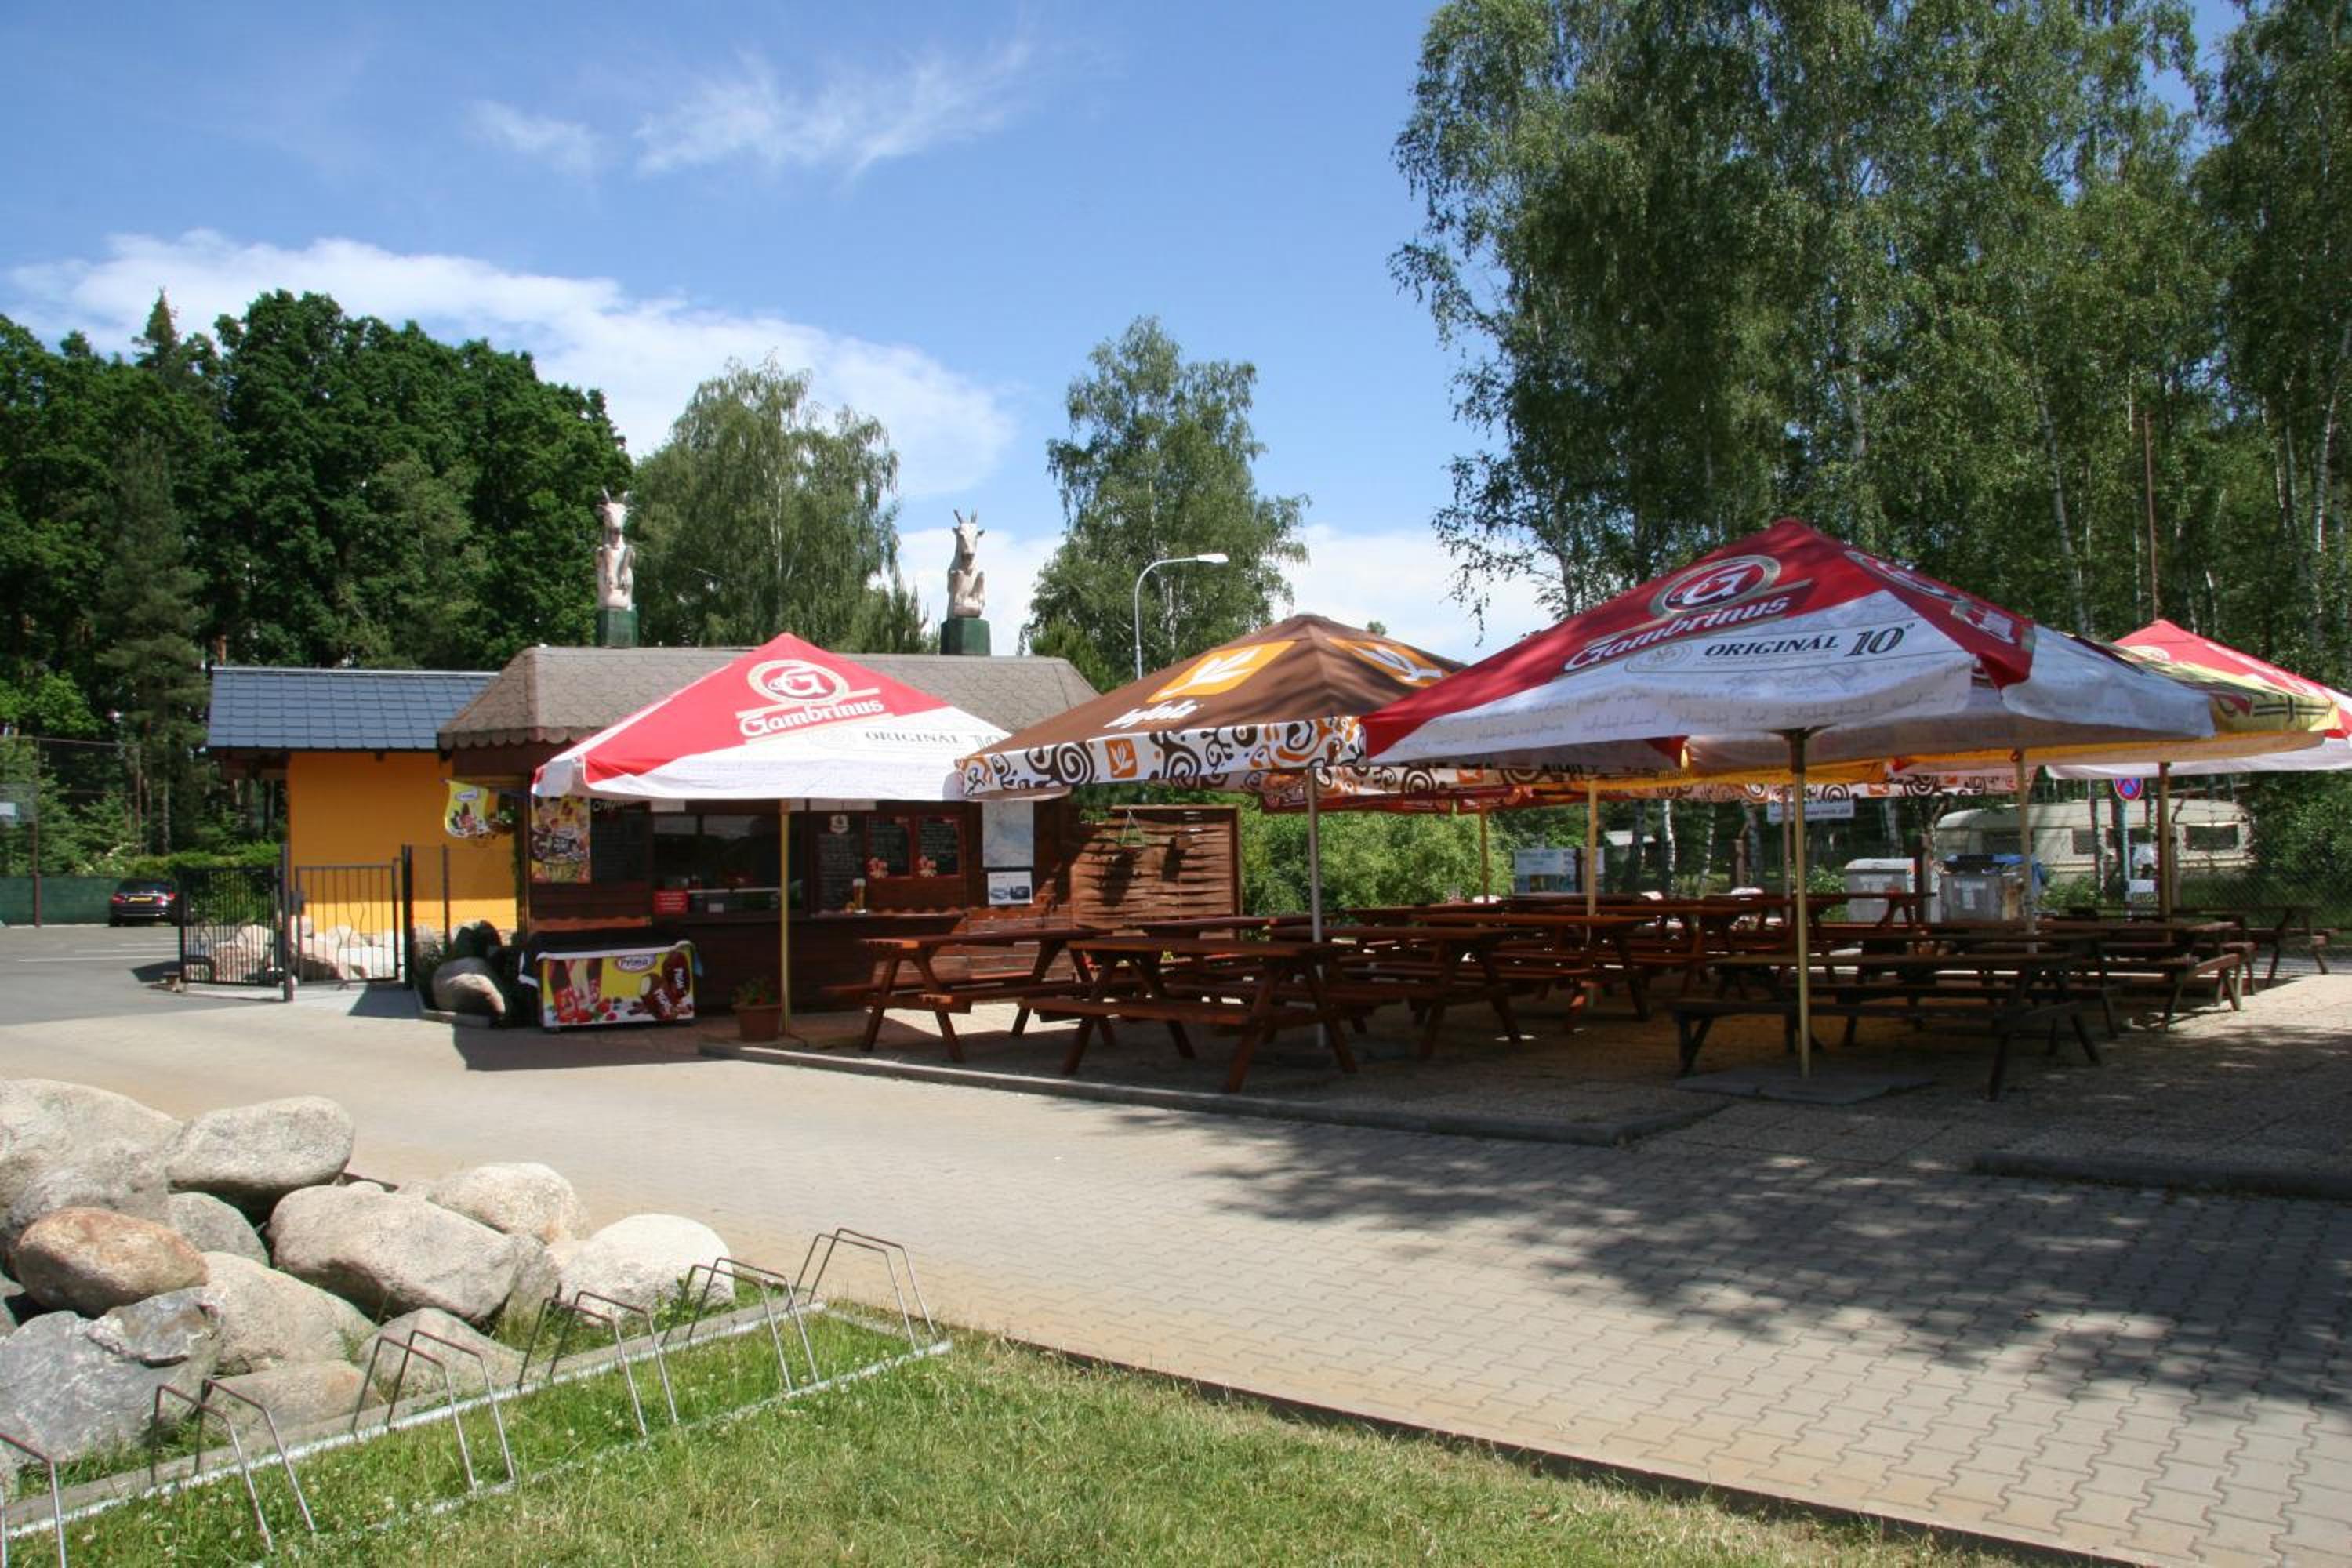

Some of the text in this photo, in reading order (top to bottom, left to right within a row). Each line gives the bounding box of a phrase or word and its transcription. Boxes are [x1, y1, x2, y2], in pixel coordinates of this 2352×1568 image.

[1564, 597, 1791, 670] Gambrinus
[1704, 635, 1838, 657] ORIGINÁL
[739, 699, 885, 737] Gambrinus
